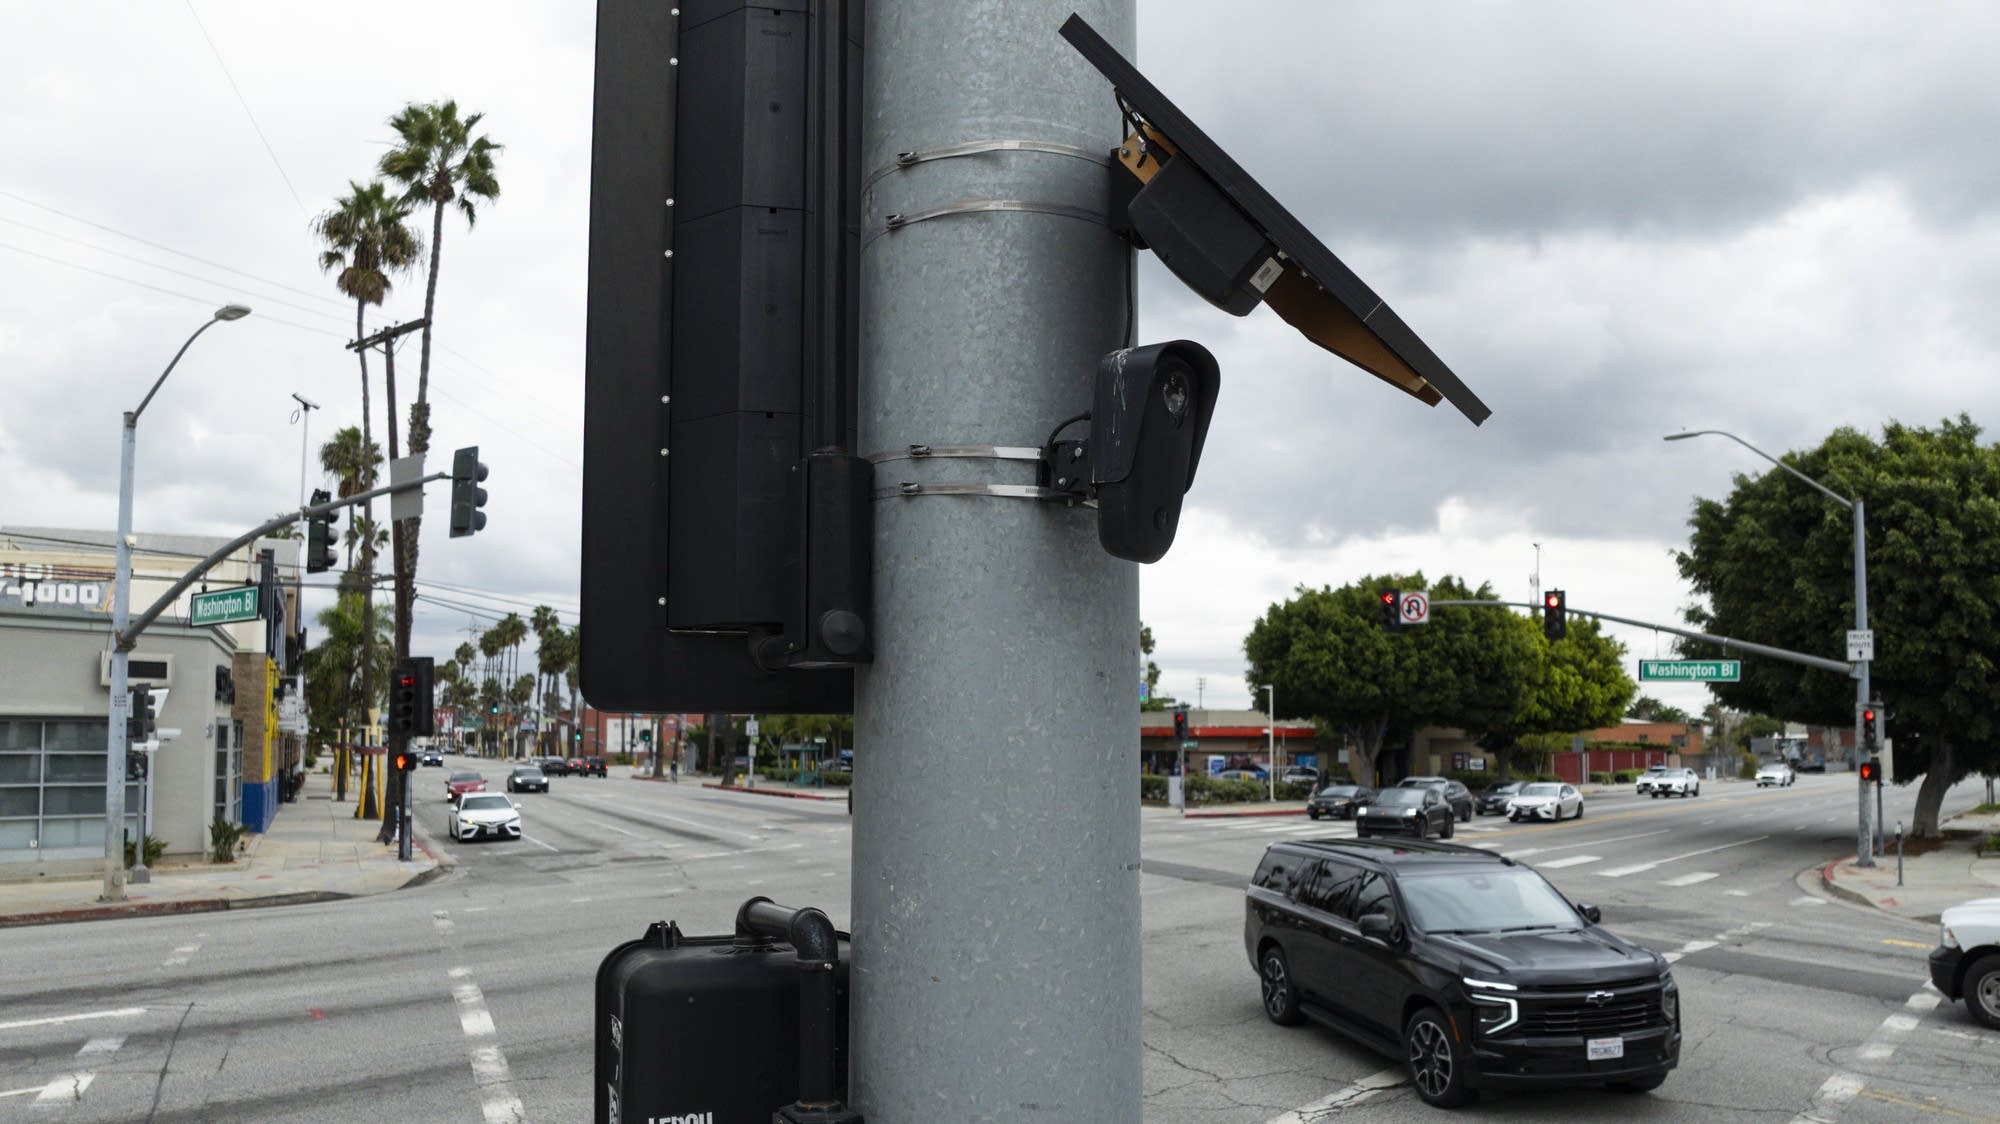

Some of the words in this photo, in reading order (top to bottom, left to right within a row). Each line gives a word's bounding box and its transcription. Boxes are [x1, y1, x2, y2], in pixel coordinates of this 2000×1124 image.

[197, 595, 242, 620] Washington
[245, 591, 254, 611] Bl
[1648, 663, 1717, 680] Washington
[1721, 663, 1734, 677] Bl
